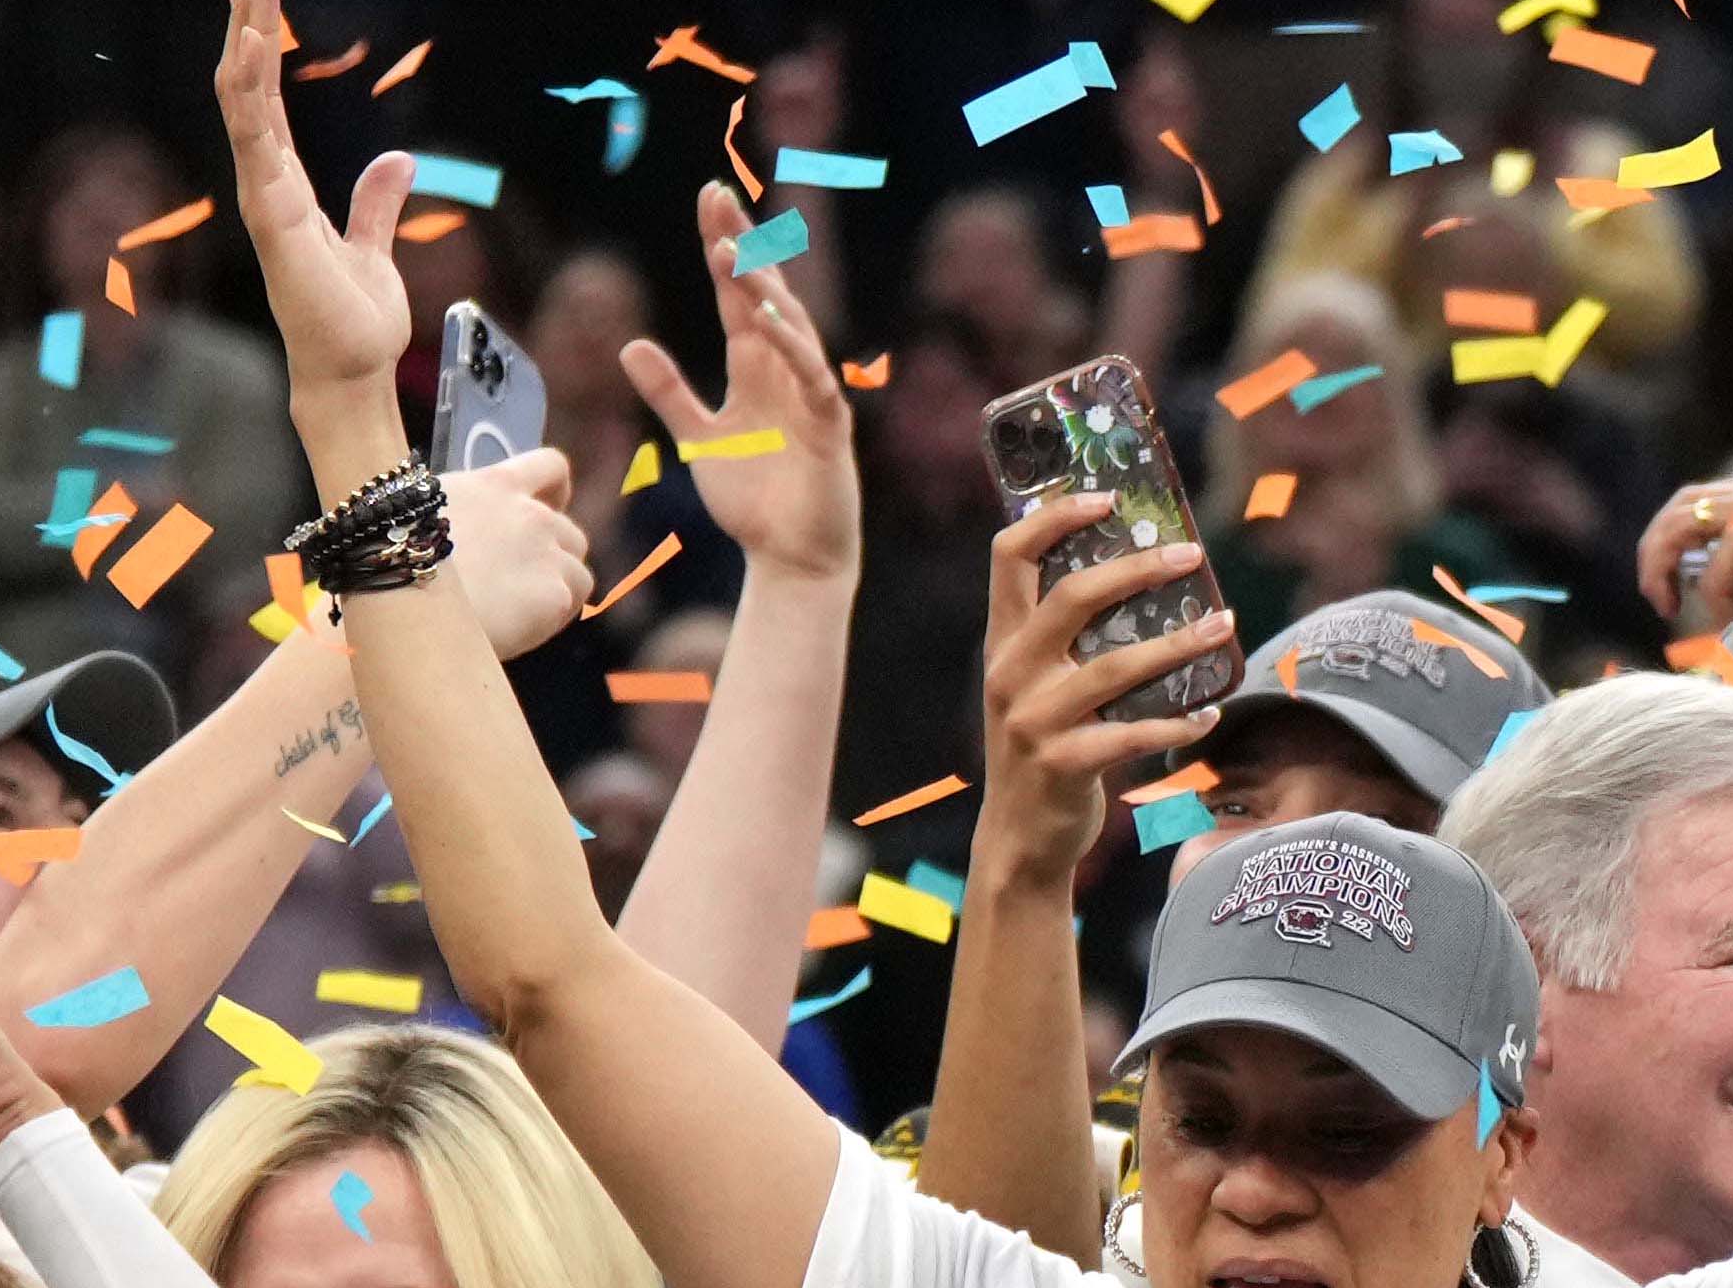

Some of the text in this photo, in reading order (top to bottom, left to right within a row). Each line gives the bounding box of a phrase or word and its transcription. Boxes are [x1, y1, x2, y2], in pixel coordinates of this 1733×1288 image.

[1235, 851, 1404, 911] NATIONAL
[1341, 842, 1413, 891] BASKETBALL
[1212, 873, 1414, 949] CHAMPIONS
[1241, 900, 1373, 941] 20 22
